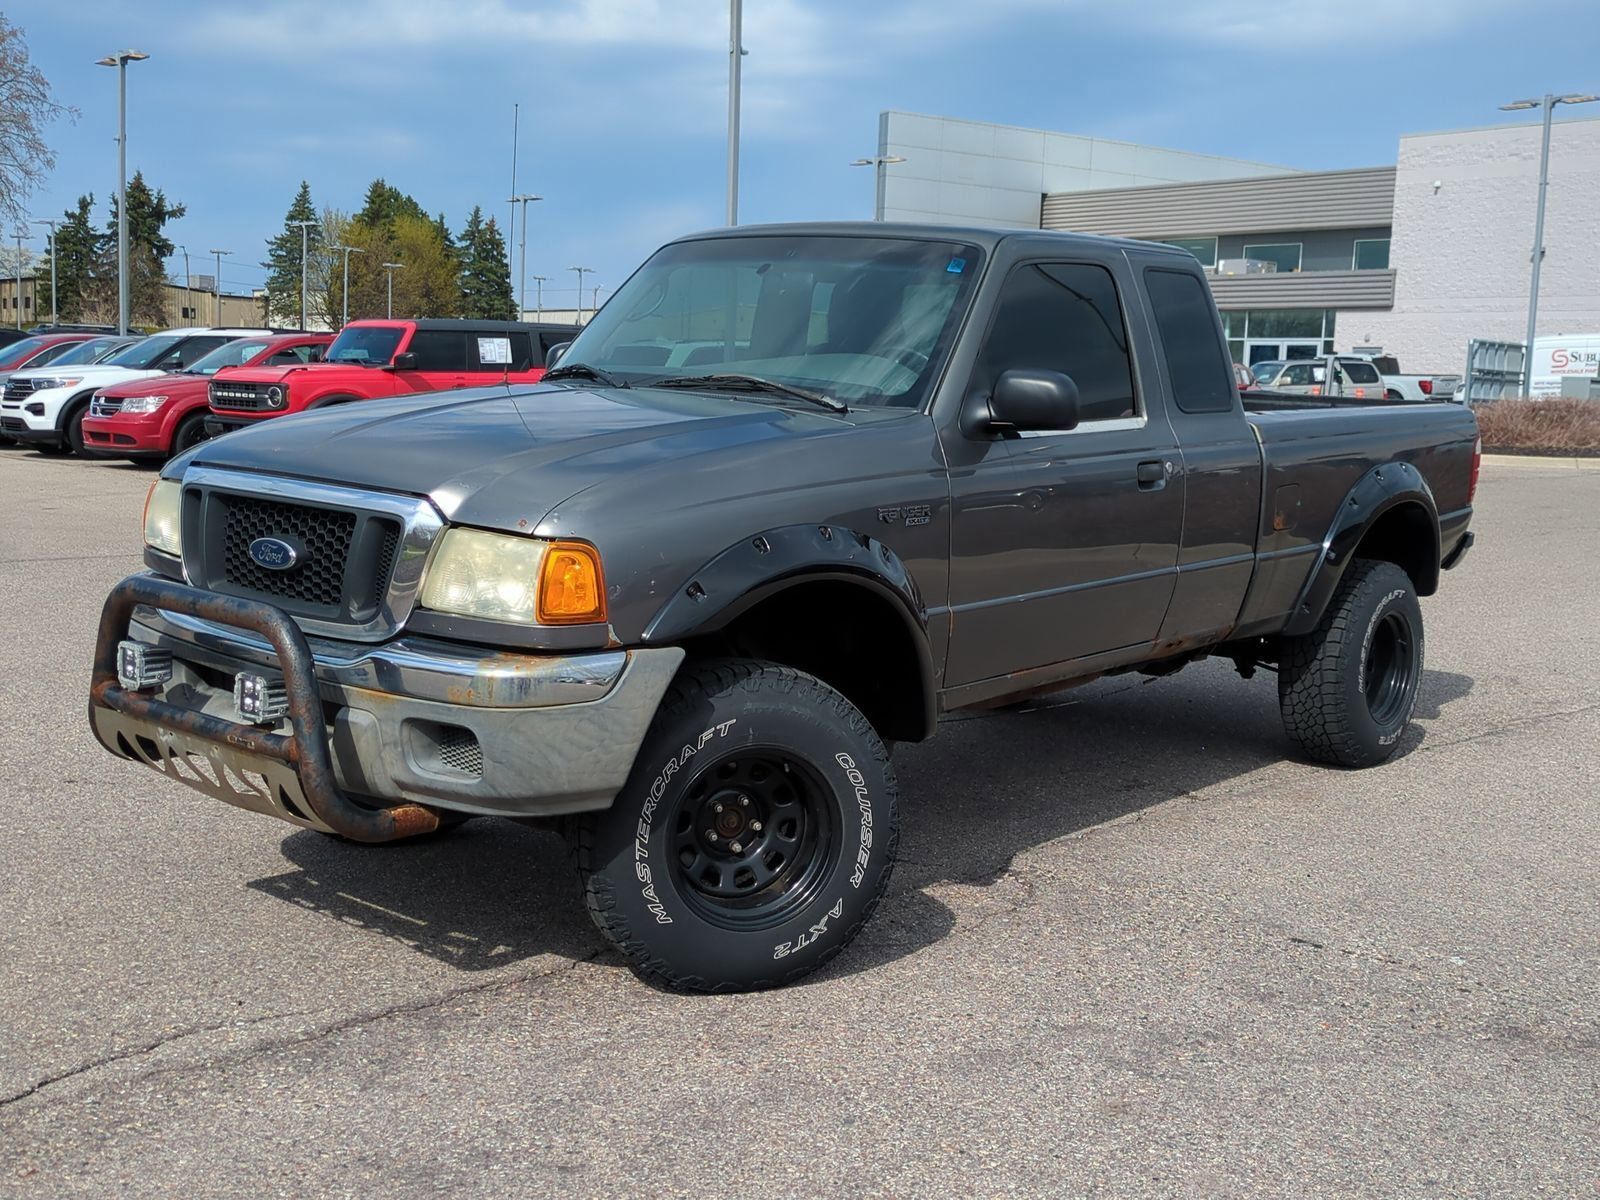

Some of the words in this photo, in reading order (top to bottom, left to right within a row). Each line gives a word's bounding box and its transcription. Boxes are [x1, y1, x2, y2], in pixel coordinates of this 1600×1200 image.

[216, 391, 256, 399] BRONCO
[878, 505, 931, 523] RANGER
[258, 542, 284, 563] Ford
[634, 718, 737, 924] MASTERCRAFT
[835, 752, 874, 889] COURSER
[772, 897, 844, 960] AXT2
